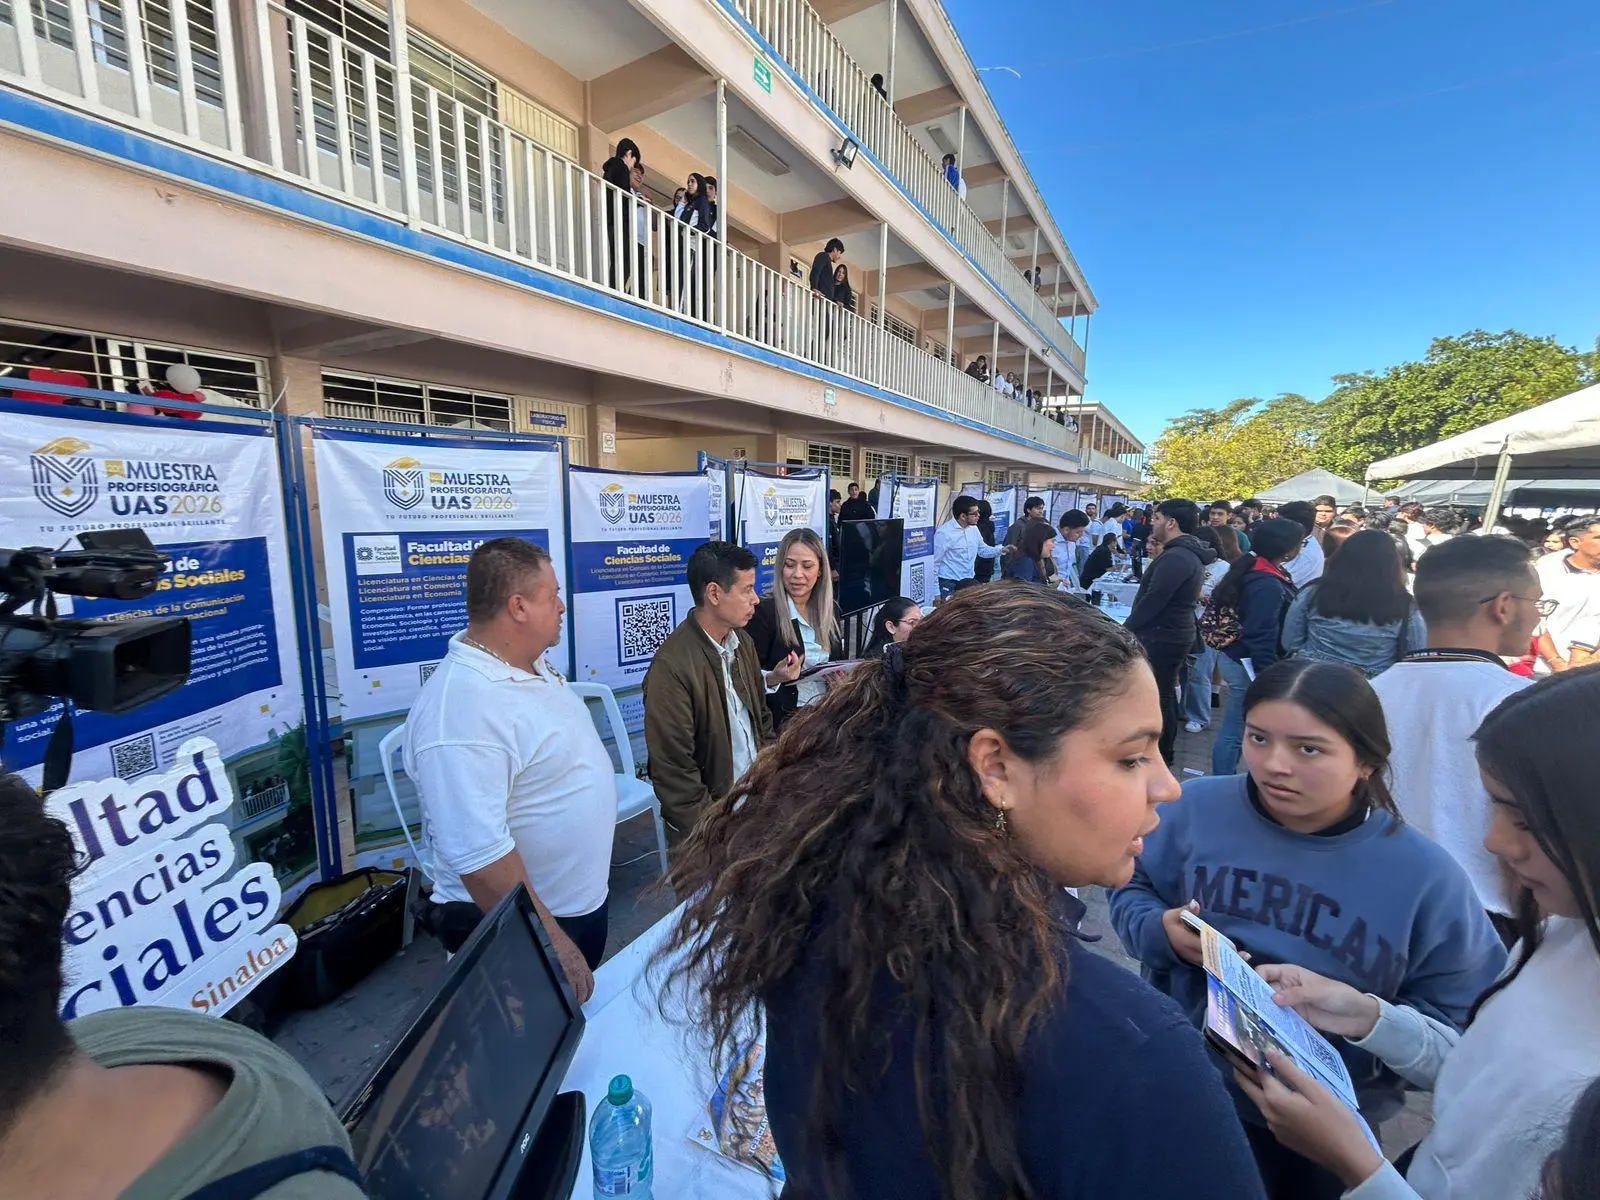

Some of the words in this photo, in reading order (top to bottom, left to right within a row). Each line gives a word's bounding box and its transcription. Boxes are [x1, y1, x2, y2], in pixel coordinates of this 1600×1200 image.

[126, 461, 217, 481] MUESTRA
[443, 472, 511, 486] MUESTRA
[107, 481, 220, 492] PROFESIOGRÁFICA
[430, 486, 513, 495] PROFESIOGRÁFICA
[110, 495, 168, 516] UAS
[170, 495, 223, 514] 2026
[431, 495, 472, 510] UAS
[473, 495, 513, 510] 2026
[637, 494, 681, 504] MUESTRA
[629, 512, 655, 524] UAS
[655, 512, 682, 523] 2026
[779, 514, 793, 526] UAS
[110, 521, 178, 530] PROFESIONAL
[407, 540, 473, 553] Facultad
[616, 544, 657, 555] Facultad
[658, 543, 671, 553] de
[764, 547, 778, 556] Cent
[176, 556, 200, 571] de
[408, 553, 471, 566] Ciencias
[604, 554, 645, 565] Ciencias
[645, 553, 682, 563] Sociales
[174, 569, 246, 587] Sociales
[358, 577, 409, 586] Licenciatura
[422, 574, 455, 582] Ciencias
[358, 585, 410, 594] Licenciatura
[423, 582, 460, 590] Comercio
[359, 593, 411, 603] Licenciatura
[424, 590, 462, 598] Economía
[107, 608, 153, 622] Ciencias
[155, 606, 169, 615] de
[171, 602, 181, 612] la
[183, 593, 245, 610] Comunicación
[360, 606, 406, 615] Compromiso:
[431, 601, 468, 609] profesionist
[15, 721, 38, 732] una
[67, 750, 220, 862] ltad
[64, 838, 223, 947] encias
[61, 875, 271, 1021] ciales
[190, 936, 289, 1016] Sinaloa
